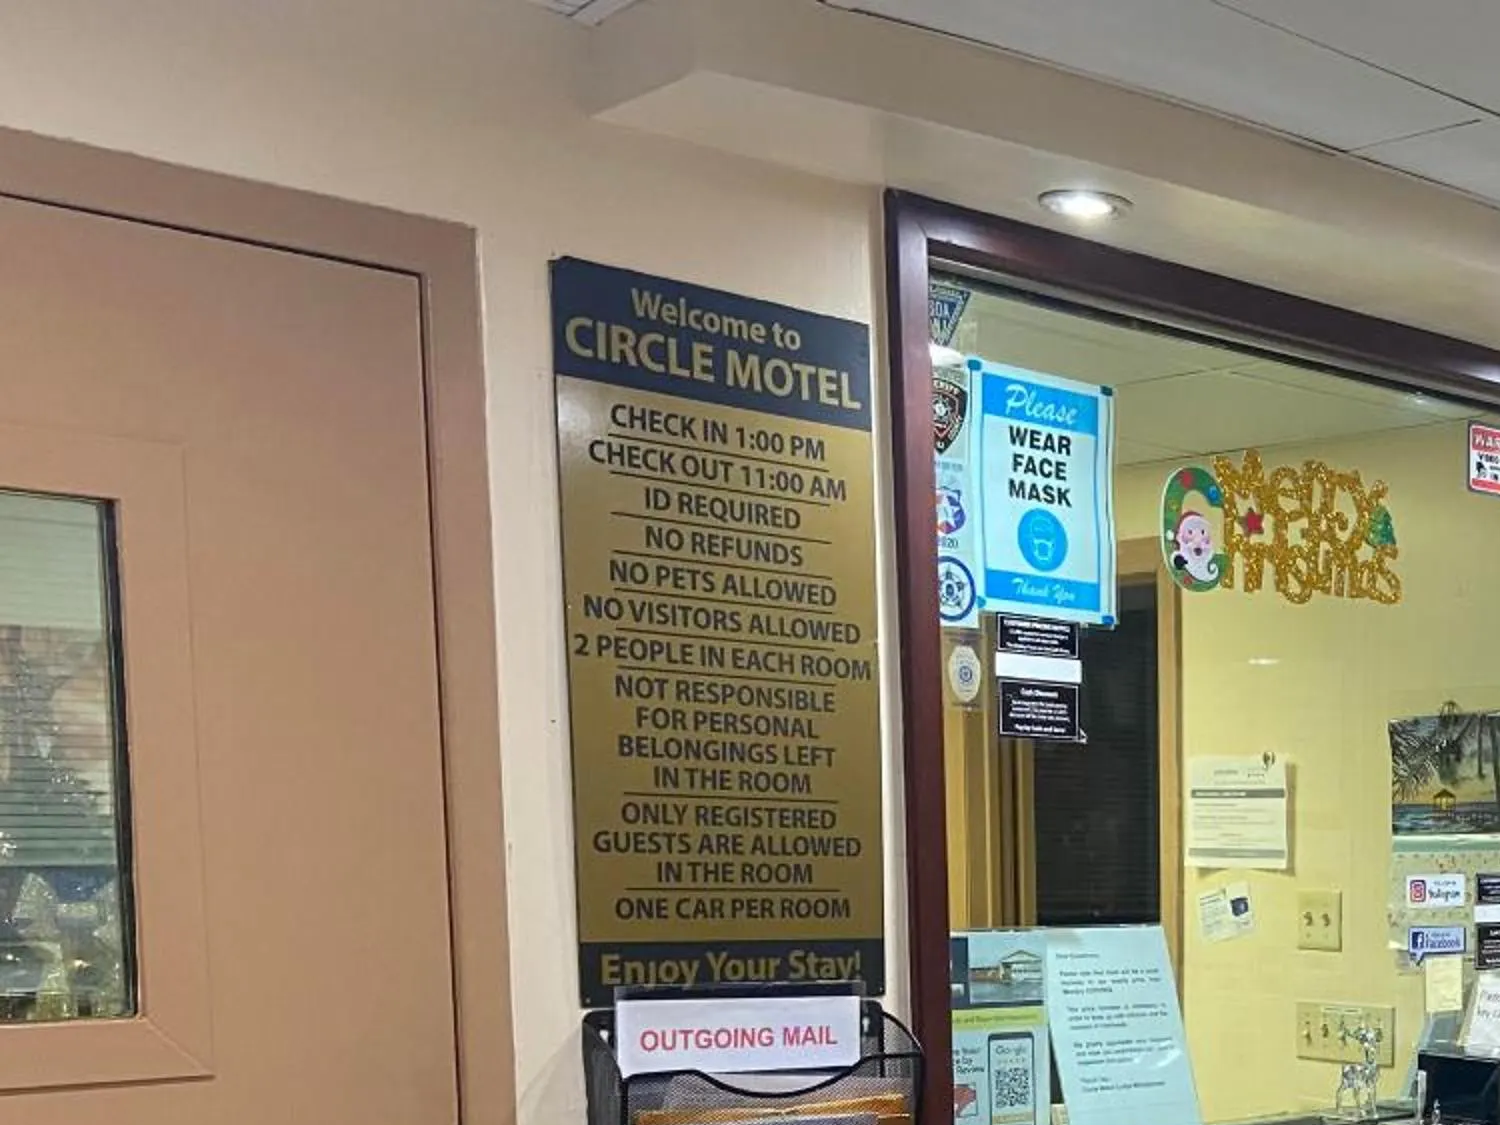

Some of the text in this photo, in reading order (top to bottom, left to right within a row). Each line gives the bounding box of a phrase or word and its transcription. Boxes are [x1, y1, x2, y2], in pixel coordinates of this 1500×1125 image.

[632, 288, 801, 351] Welcome to
[565, 317, 862, 410] CIRCLE MOTEL
[1005, 384, 1078, 424] Please
[611, 404, 825, 461] CHECK IN 1:00 PM
[1009, 426, 1071, 456] WEAR
[589, 439, 846, 501] CHECK OUT 11:00 AM
[1013, 454, 1066, 481] FACE
[645, 487, 801, 530] ID REQUIRED
[1009, 480, 1072, 507] MASK
[646, 526, 803, 567] NO REFUNDS
[610, 560, 836, 607] NO PETS ALLOWED
[584, 594, 861, 644] NO VISITORS ALLOWED
[574, 634, 872, 680] 2 PEOPLE IN EACH ROOM
[615, 675, 835, 713] NOT RESPONSIBLE
[636, 707, 820, 739] FOR PERSONAL
[618, 735, 835, 768] BELONGINGS LEFT
[654, 766, 812, 794] IN THE ROOM
[622, 802, 836, 829] ONLY REGISTERED
[593, 831, 861, 857] GUESTS ARE ALLOWED
[657, 862, 813, 884] IN THE ROOM
[615, 898, 851, 919] ONE CAR PER ROOM
[602, 949, 861, 987] Enjoy Your Stay!
[640, 1026, 838, 1052] OUTGOING MAIL
